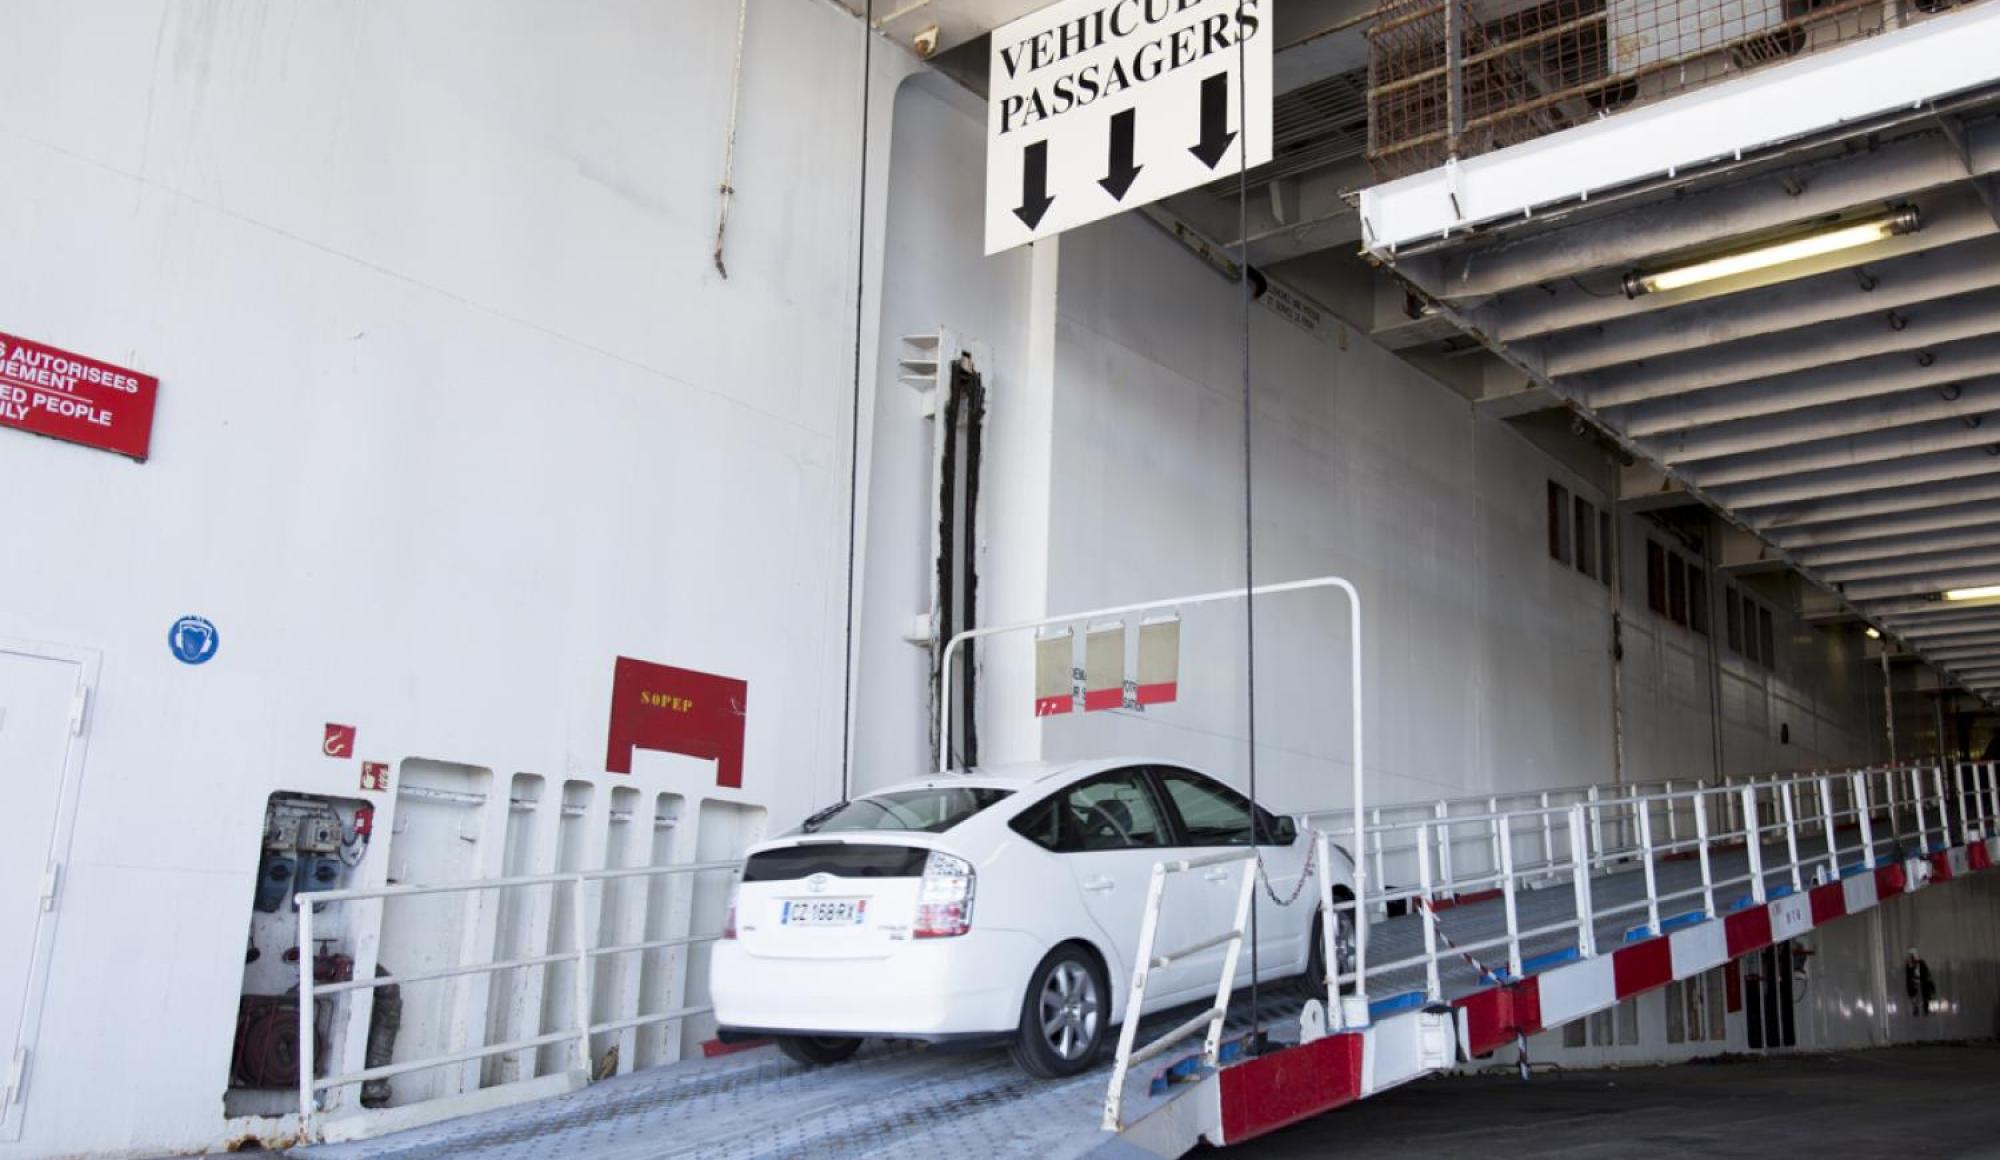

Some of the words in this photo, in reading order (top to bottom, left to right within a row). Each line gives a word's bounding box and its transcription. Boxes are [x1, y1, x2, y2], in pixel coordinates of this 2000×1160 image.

[998, 0, 1259, 135] PASSAGERS
[11, 346, 138, 393] AUTORISEES
[32, 392, 113, 426] PEOPLE
[641, 690, 693, 712] SOPEP
